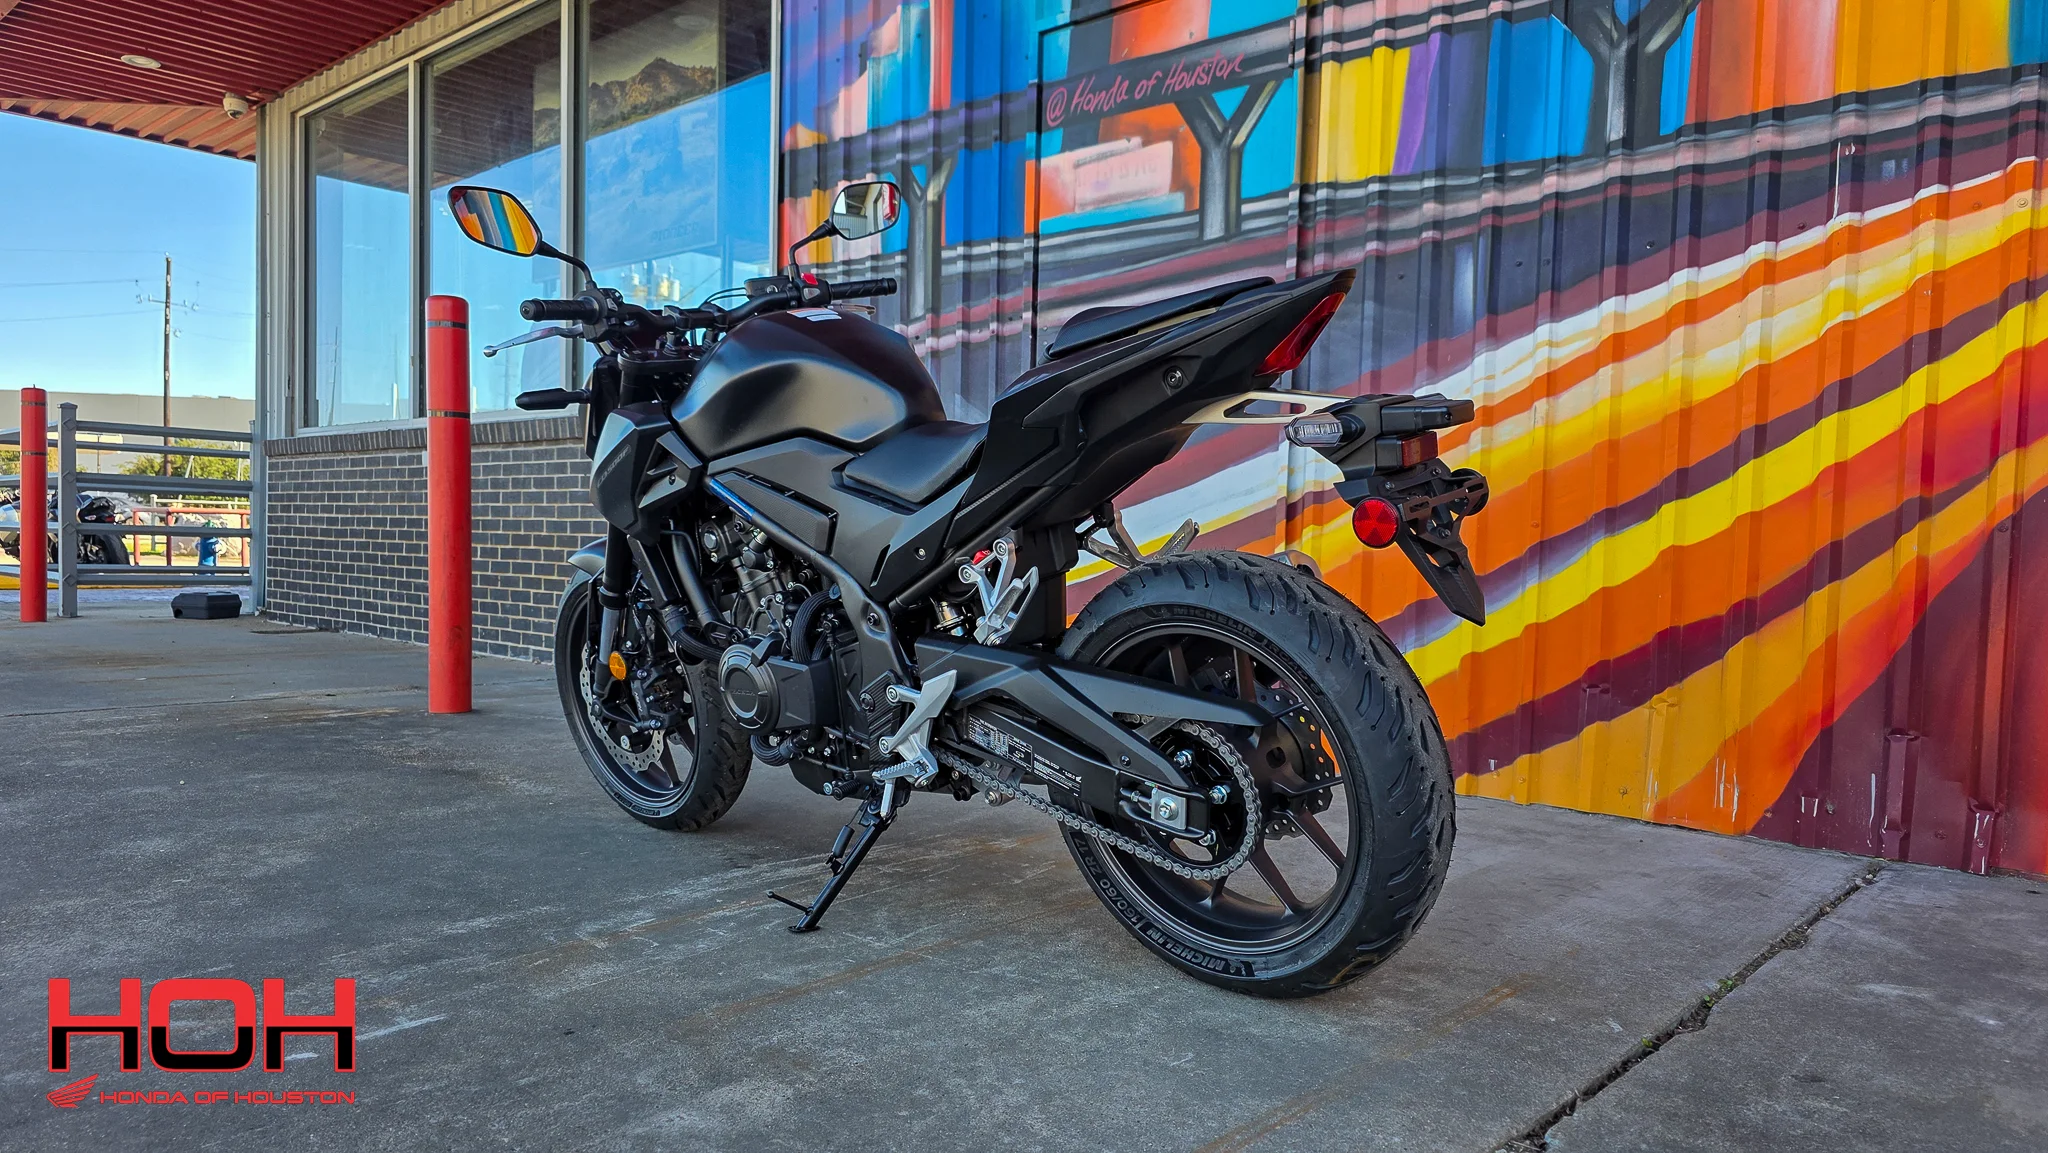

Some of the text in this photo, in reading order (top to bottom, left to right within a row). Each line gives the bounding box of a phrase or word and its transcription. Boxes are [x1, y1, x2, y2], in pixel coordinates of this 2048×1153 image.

[1046, 50, 1245, 127] @ Honda of Houston
[1173, 606, 1258, 639] MICHELIN
[1074, 838, 1227, 972] MICHELIN 160/60 ZR 17
